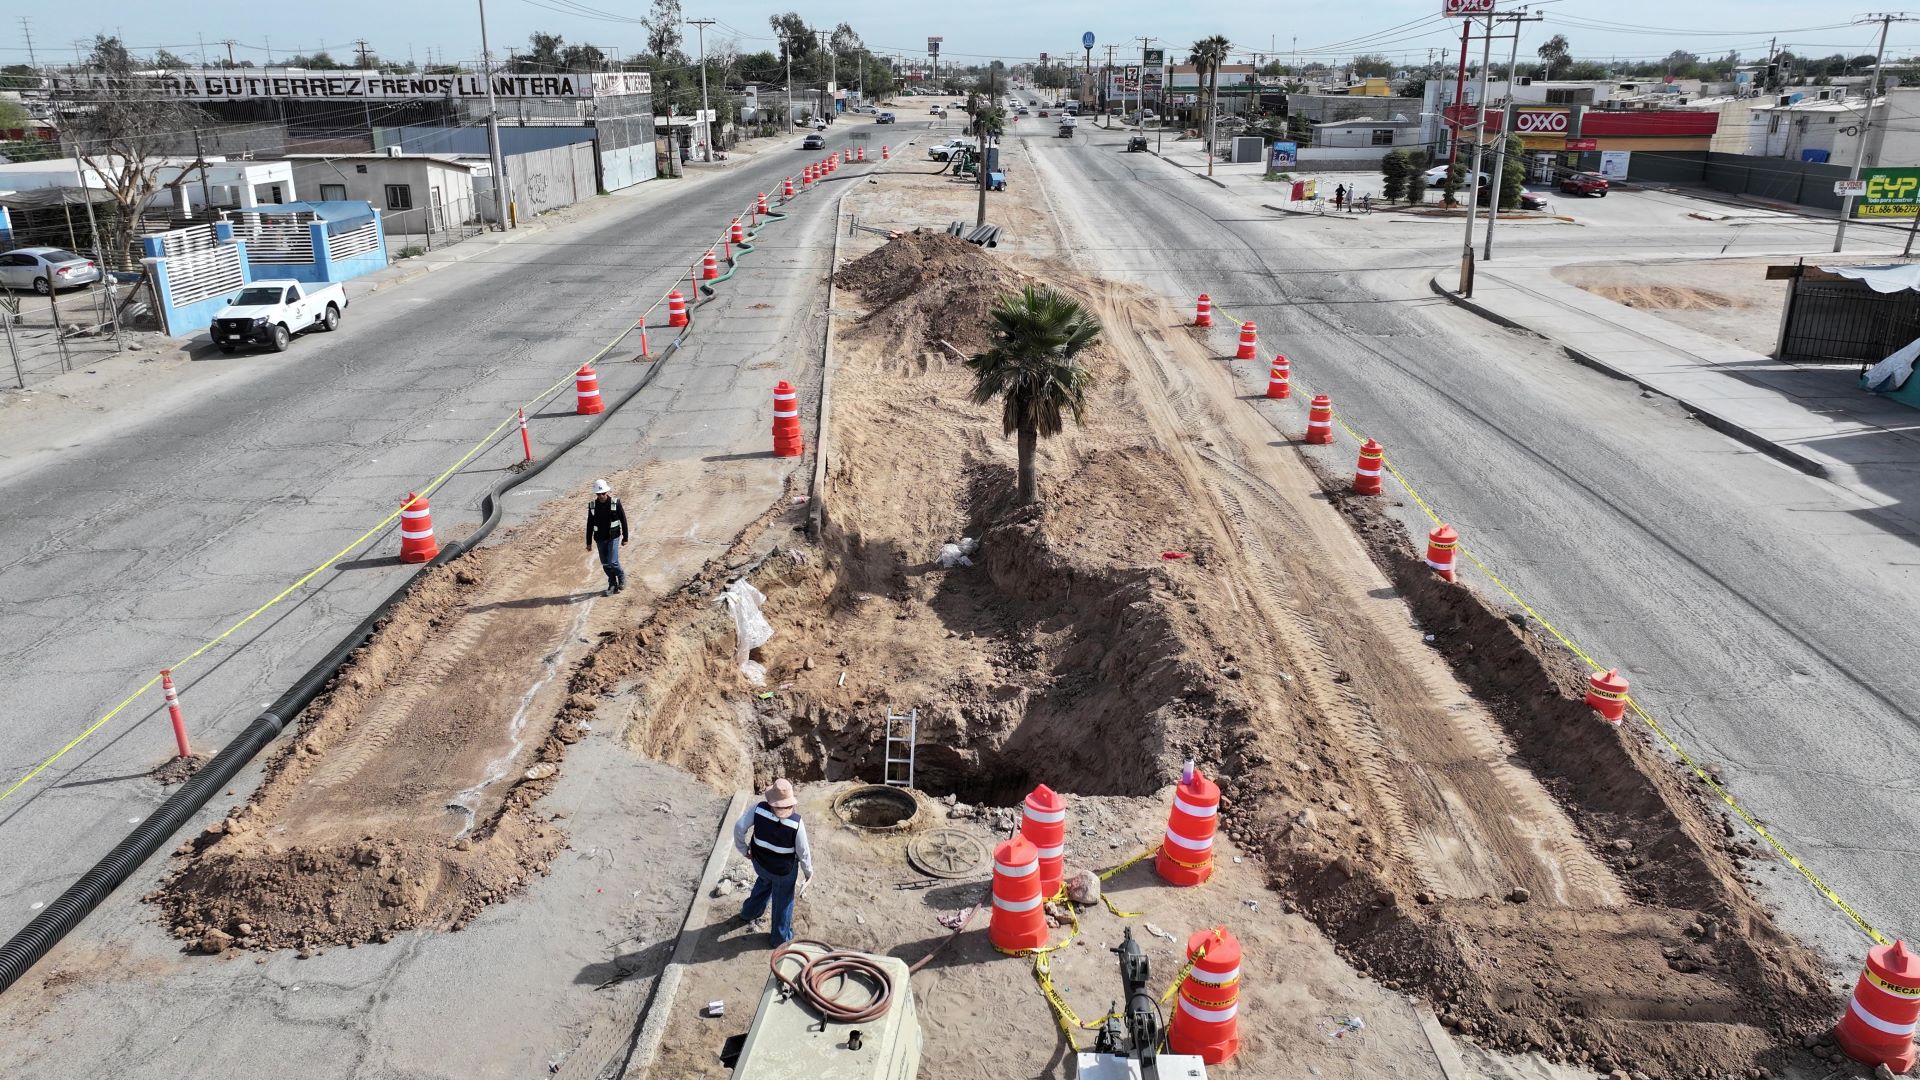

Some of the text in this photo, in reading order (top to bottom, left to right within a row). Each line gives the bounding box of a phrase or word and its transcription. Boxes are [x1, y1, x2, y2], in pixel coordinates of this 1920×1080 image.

[205, 76, 363, 96] GUTIERREZ
[367, 78, 452, 94] FRENOS
[457, 76, 575, 96] LLANTERA
[1517, 112, 1568, 133] OXXO
[1866, 177, 1918, 199] EYP
